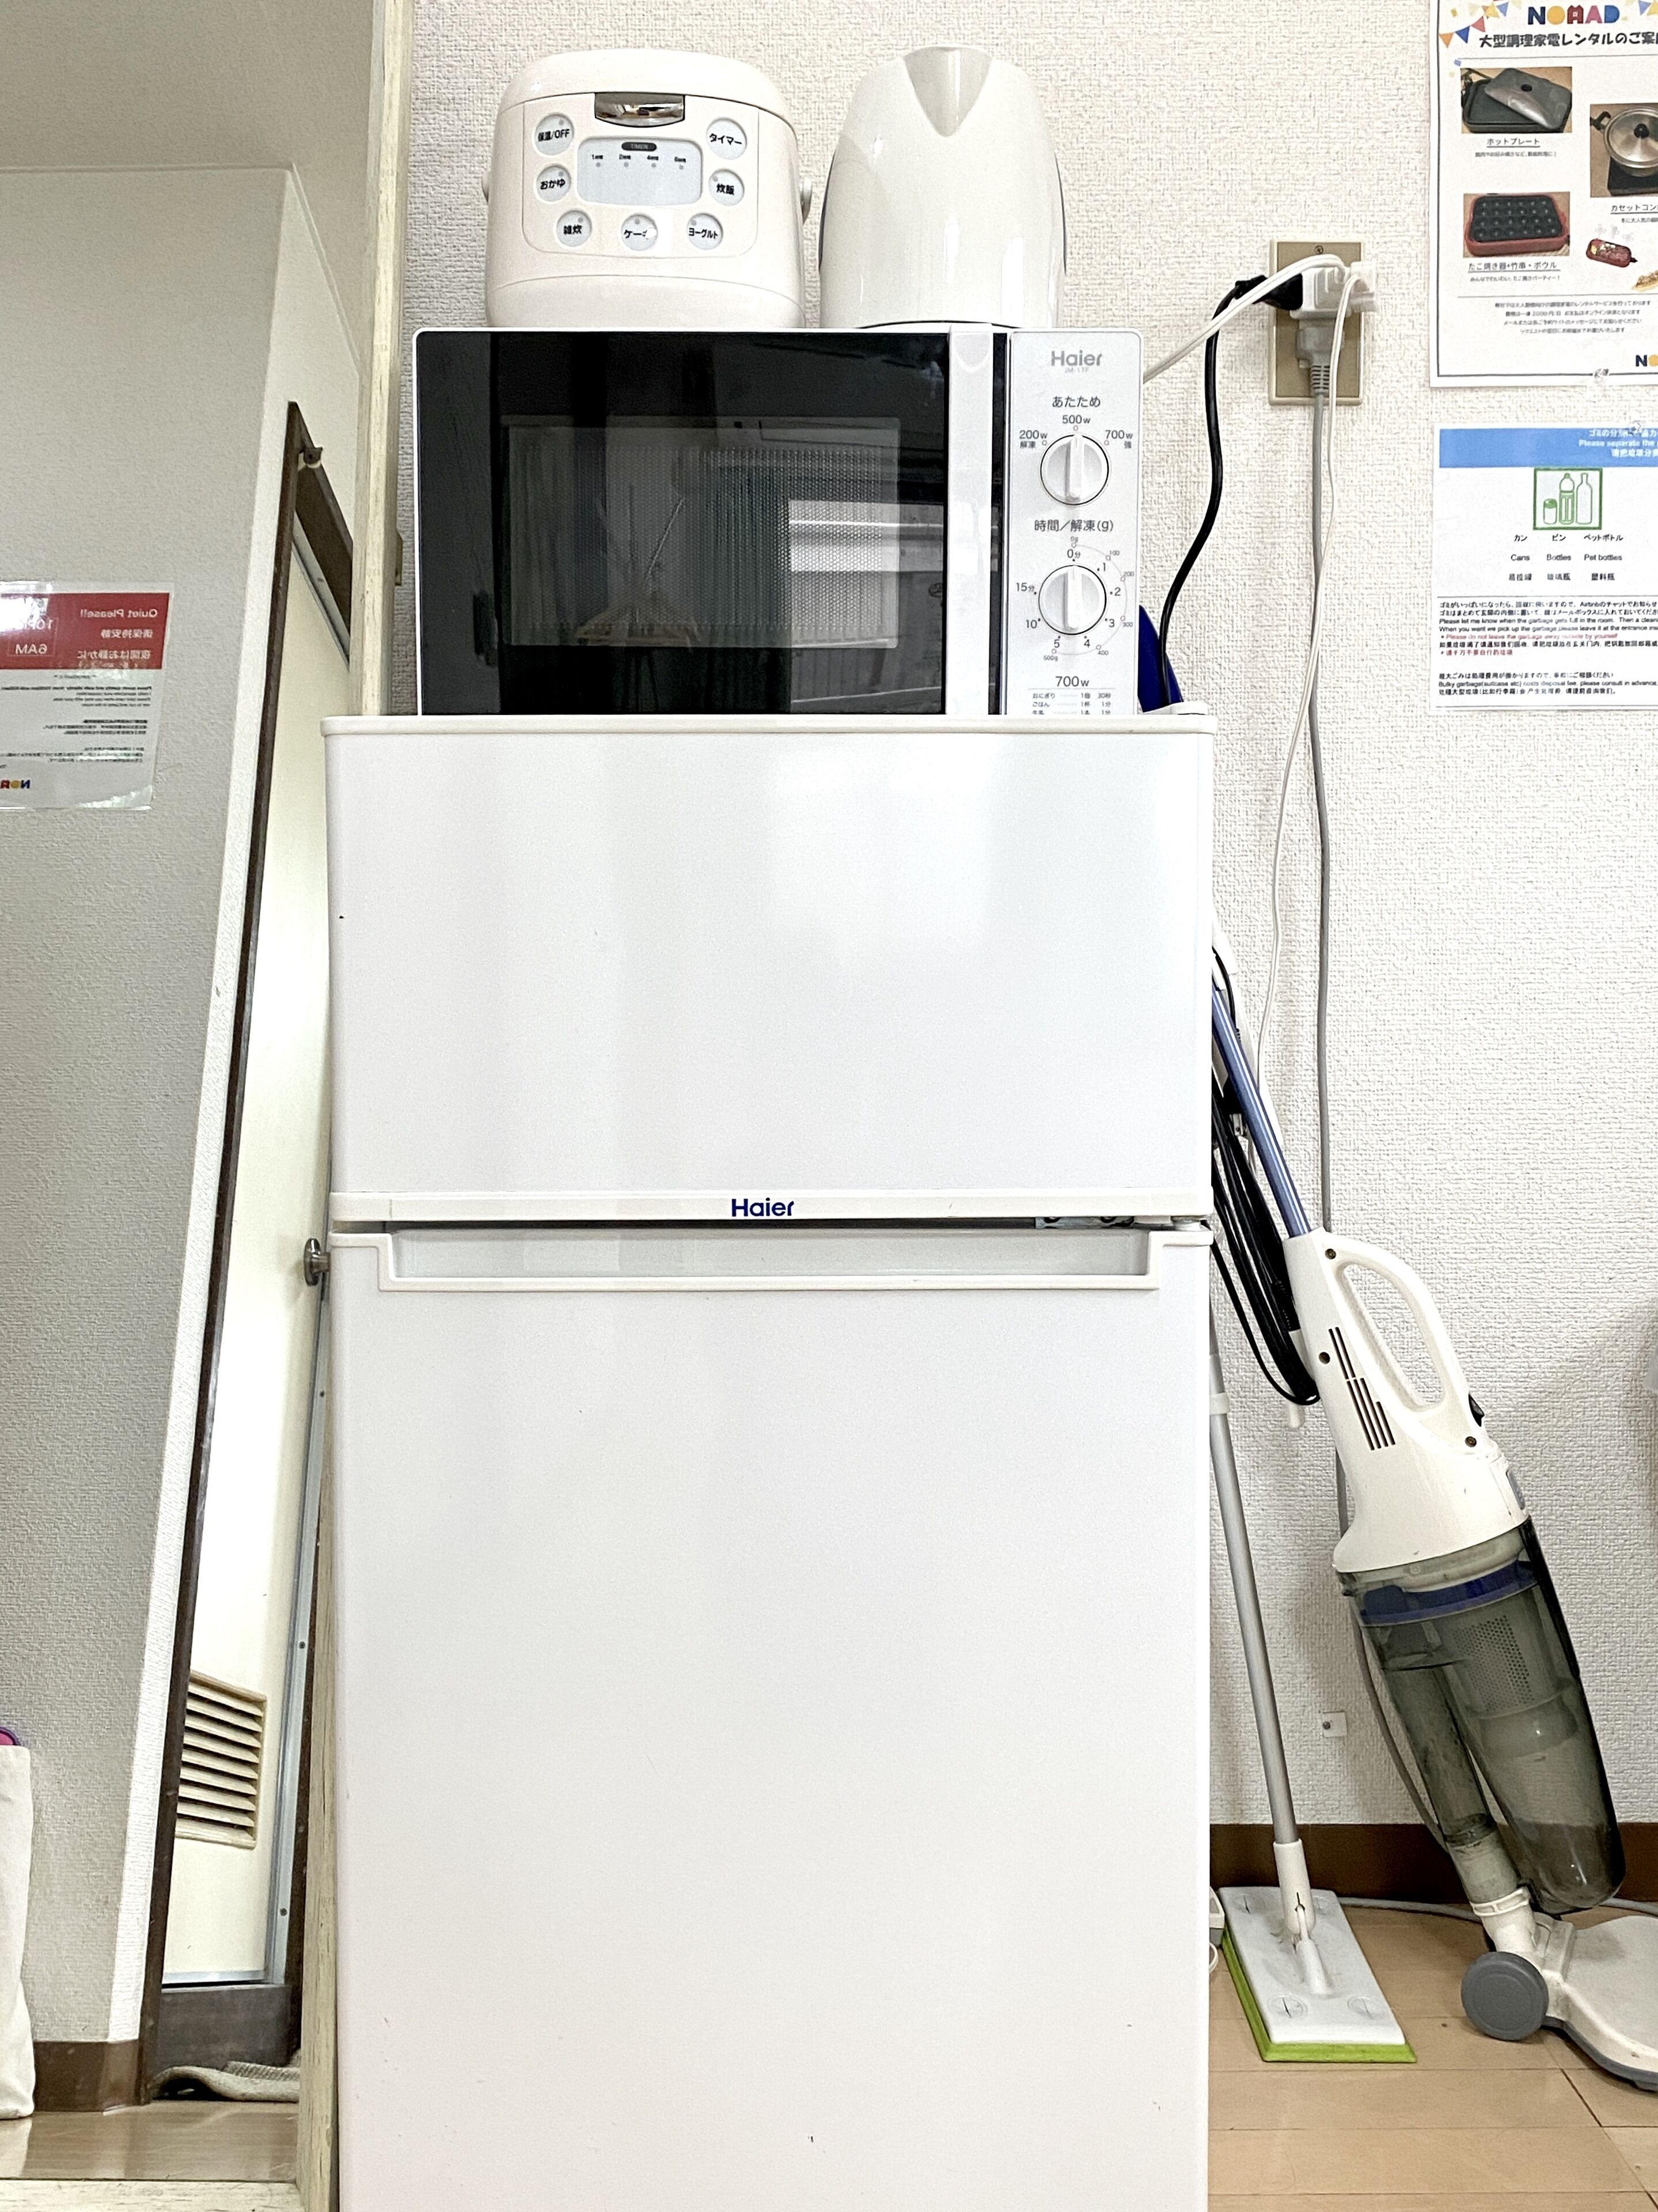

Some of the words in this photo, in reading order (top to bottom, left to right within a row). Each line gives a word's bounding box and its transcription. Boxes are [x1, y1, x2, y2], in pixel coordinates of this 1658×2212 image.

[709, 133, 743, 146] タイマー
[540, 179, 566, 190] おかゆ
[716, 183, 735, 196] 炊飯
[1611, 204, 1658, 212] カセットコン
[689, 228, 719, 239] ヨーグルト
[1051, 349, 1102, 366] Haier
[1052, 396, 1101, 408] あたため
[1552, 533, 1566, 541] ビン
[1067, 549, 1081, 558] 0分
[1102, 563, 1106, 571] 1
[1016, 582, 1035, 592] 15分
[1114, 588, 1121, 596] 2
[1026, 620, 1037, 628] 10
[1109, 619, 1116, 628] 3
[1054, 639, 1060, 648] 5
[1084, 639, 1090, 648] 4
[731, 1197, 794, 1217] Haier
